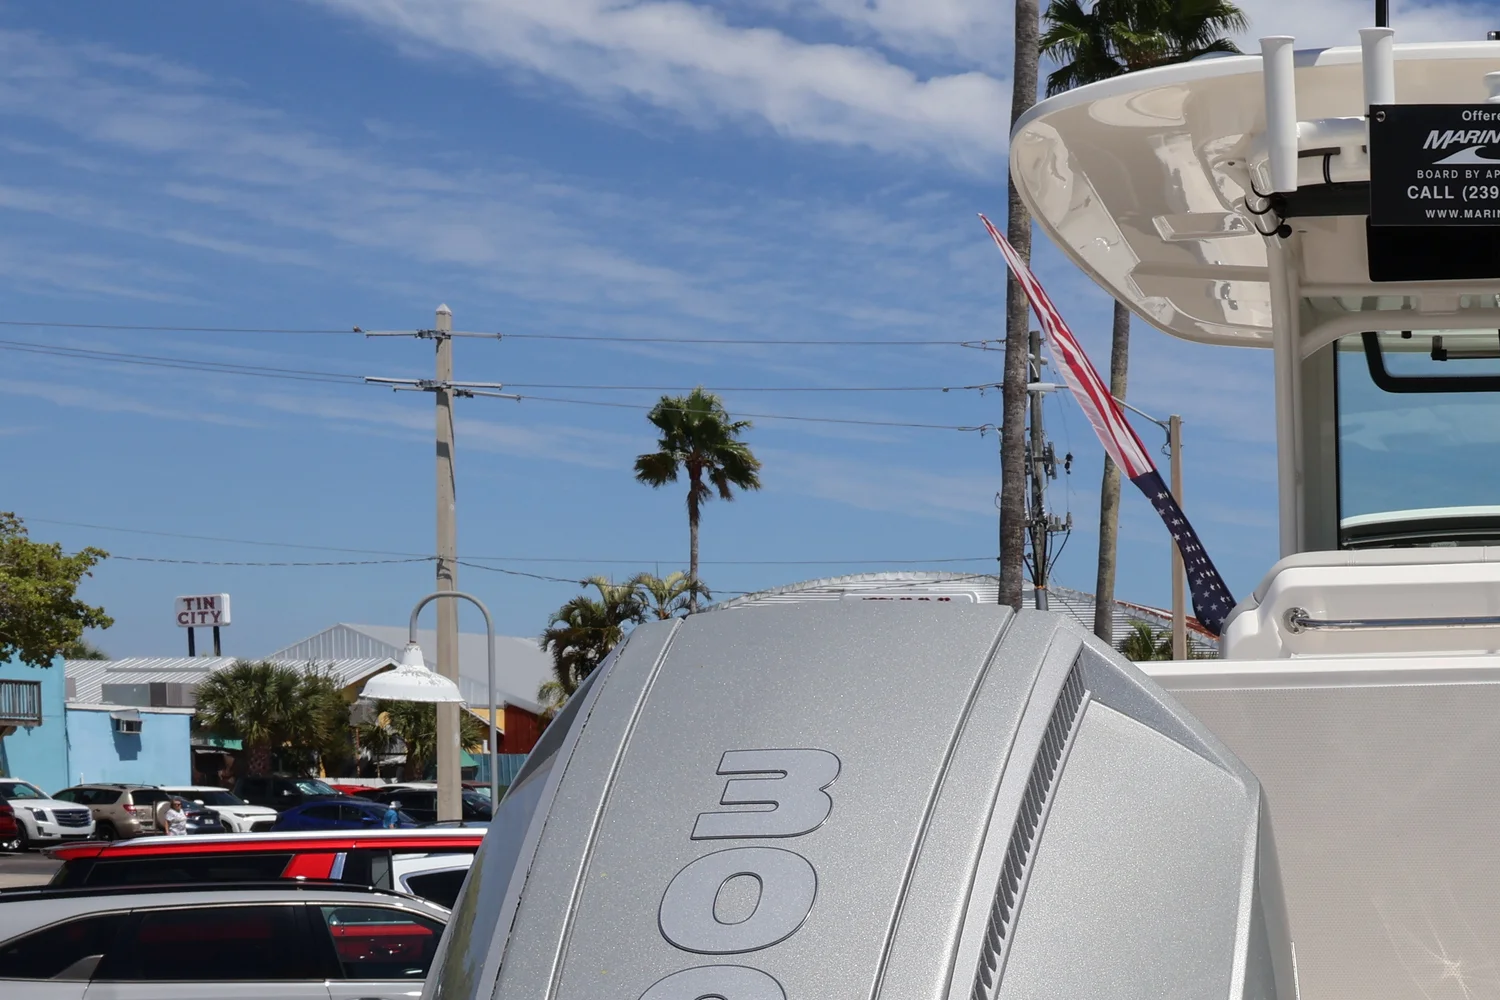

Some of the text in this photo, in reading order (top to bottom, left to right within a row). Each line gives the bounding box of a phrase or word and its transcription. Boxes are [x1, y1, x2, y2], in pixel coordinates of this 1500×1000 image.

[1417, 169, 1459, 179] BOARD
[1465, 169, 1480, 179] BY
[1406, 185, 1455, 199] CALL
[183, 596, 215, 611] TIN
[177, 610, 222, 624] CITY
